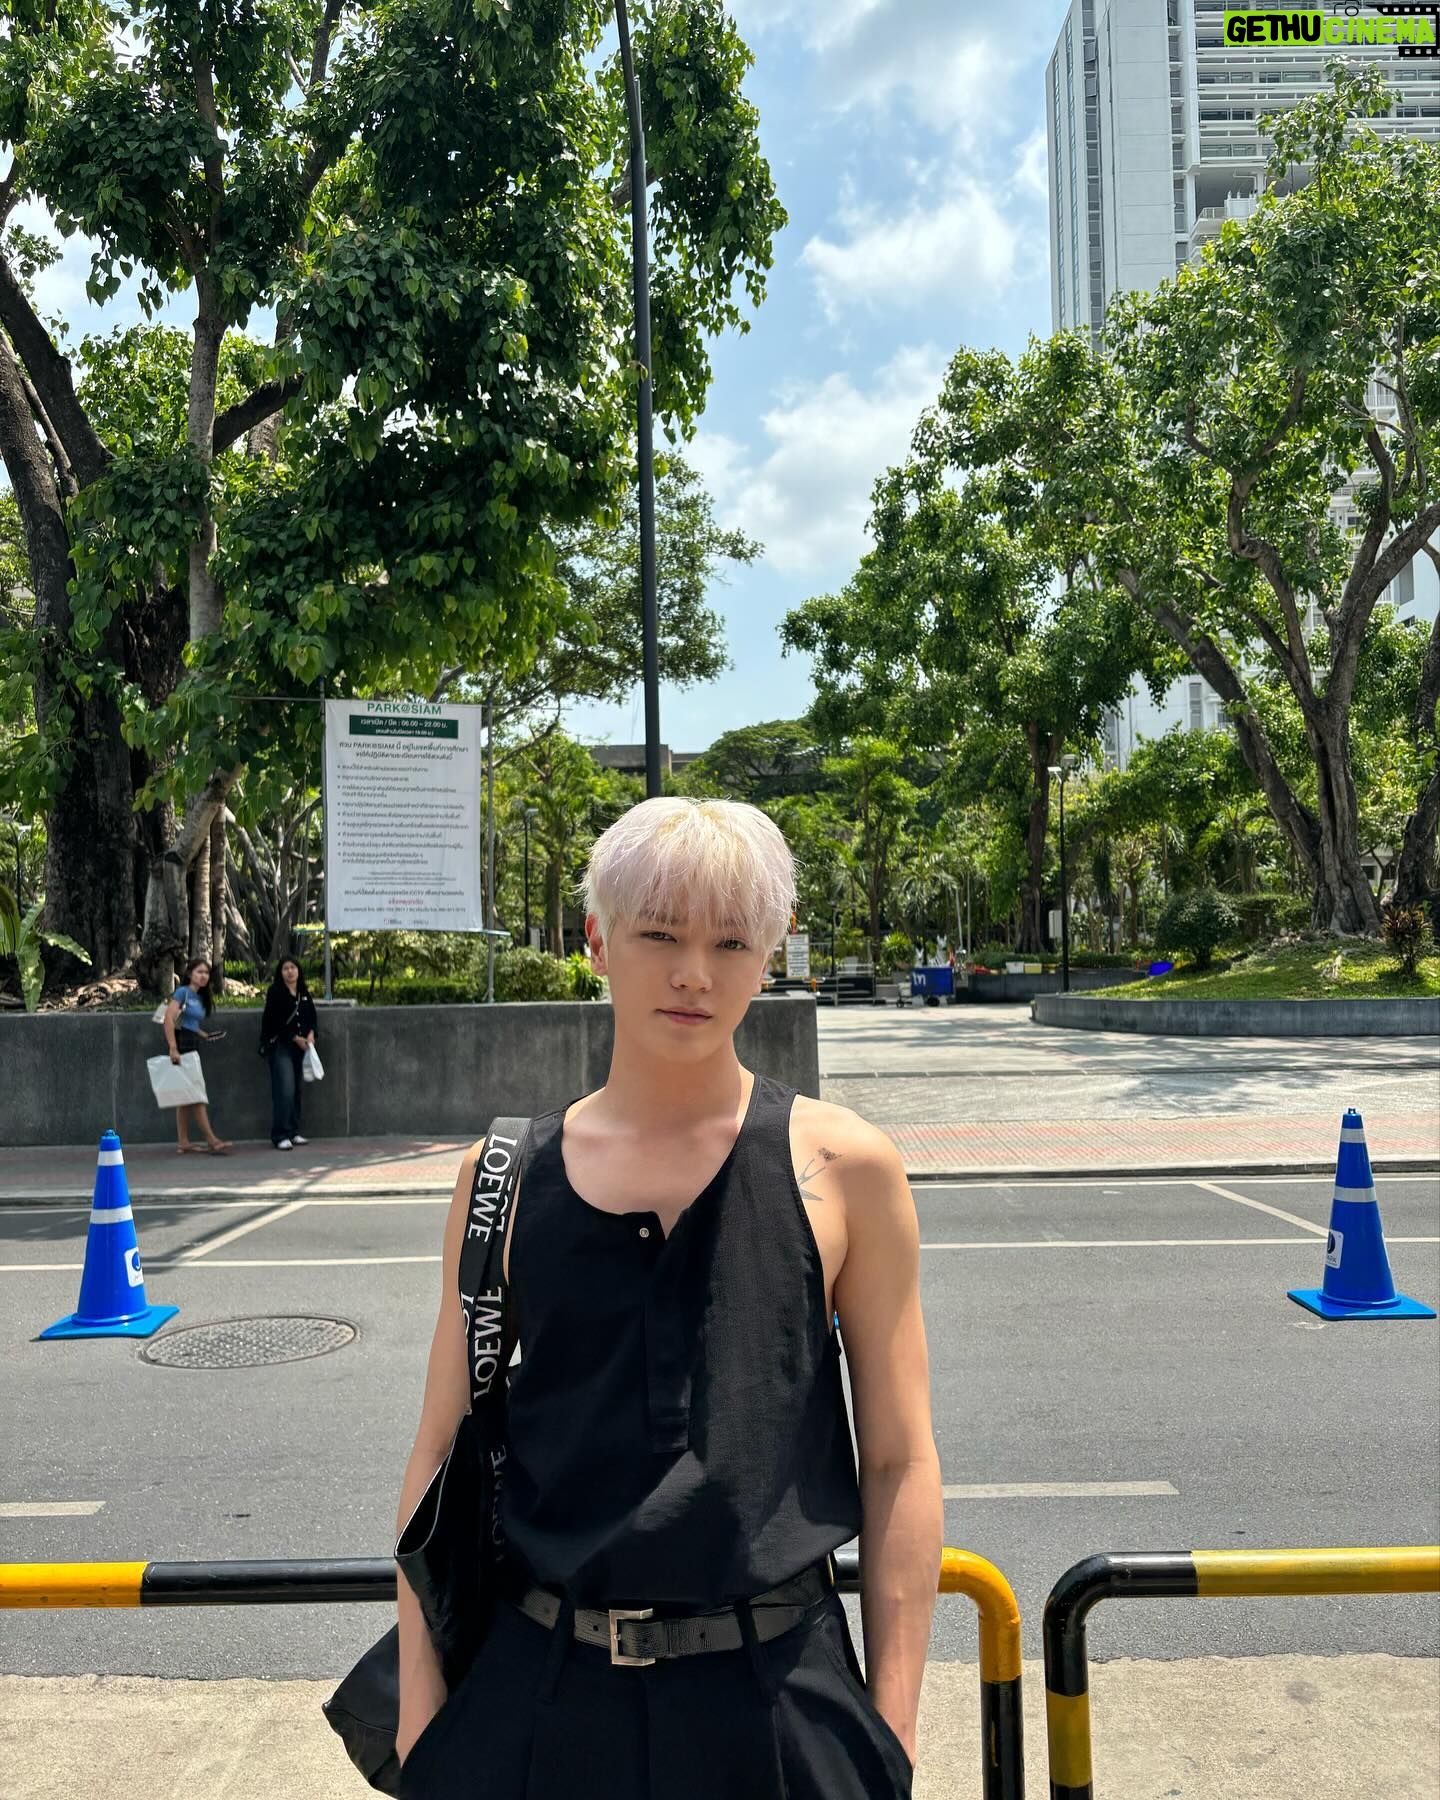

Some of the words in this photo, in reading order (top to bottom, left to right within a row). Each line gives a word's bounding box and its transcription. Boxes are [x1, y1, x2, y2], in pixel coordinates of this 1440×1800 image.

[367, 703, 442, 715] PARK@SIAM
[424, 720, 441, 729] 22.00
[468, 1133, 518, 1243] LOEWE
[473, 1285, 502, 1400] LOEWE
